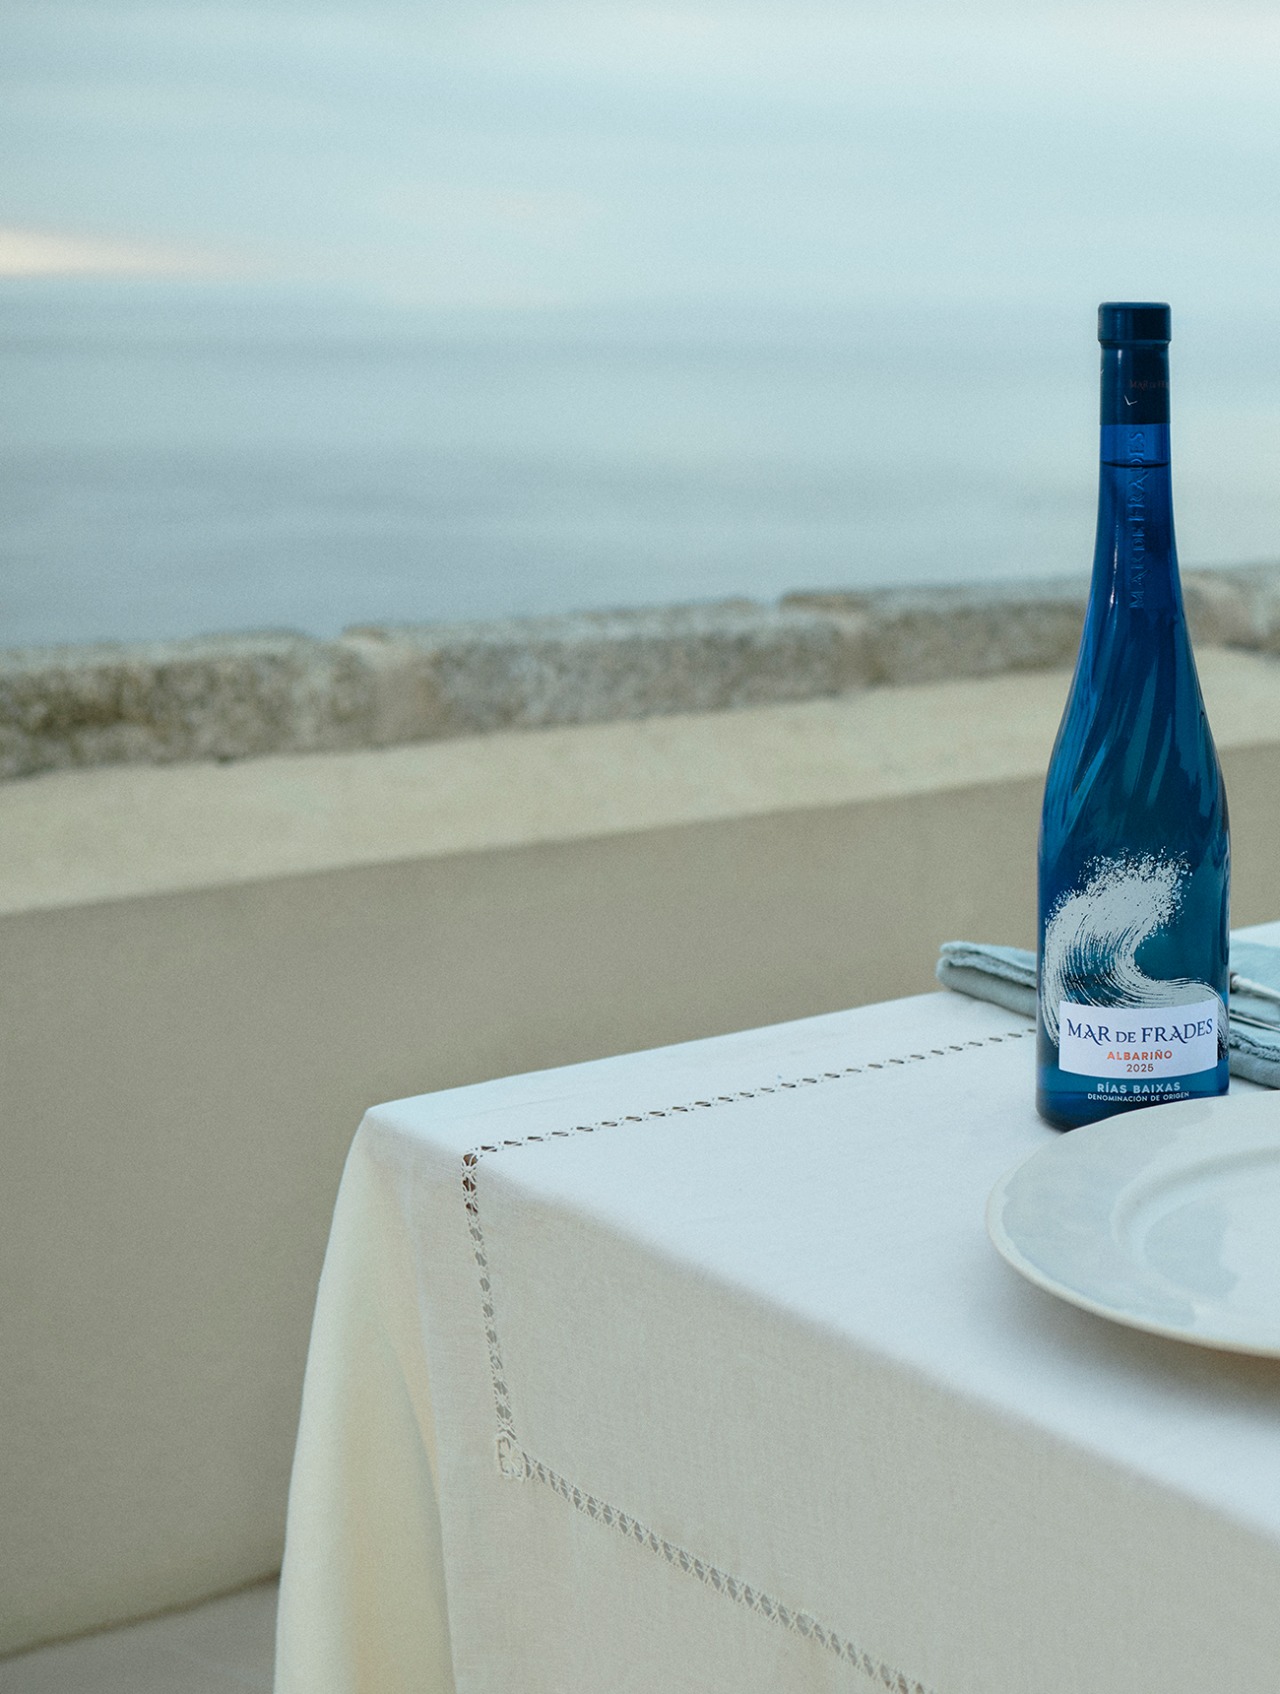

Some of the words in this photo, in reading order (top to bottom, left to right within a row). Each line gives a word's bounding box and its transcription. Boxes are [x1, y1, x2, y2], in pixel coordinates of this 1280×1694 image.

[1066, 1018, 1112, 1046] MAR
[1116, 1031, 1136, 1043] DE
[1141, 1018, 1213, 1044] FRADES
[1107, 1050, 1173, 1061] ALBARIÑO
[1097, 1082, 1127, 1094] RÍAS
[1133, 1082, 1181, 1094] BAIXAS
[1087, 1092, 1148, 1102] DENOMINACIÓN
[1151, 1093, 1161, 1102] DE
[1163, 1091, 1190, 1101] ORIGEN
